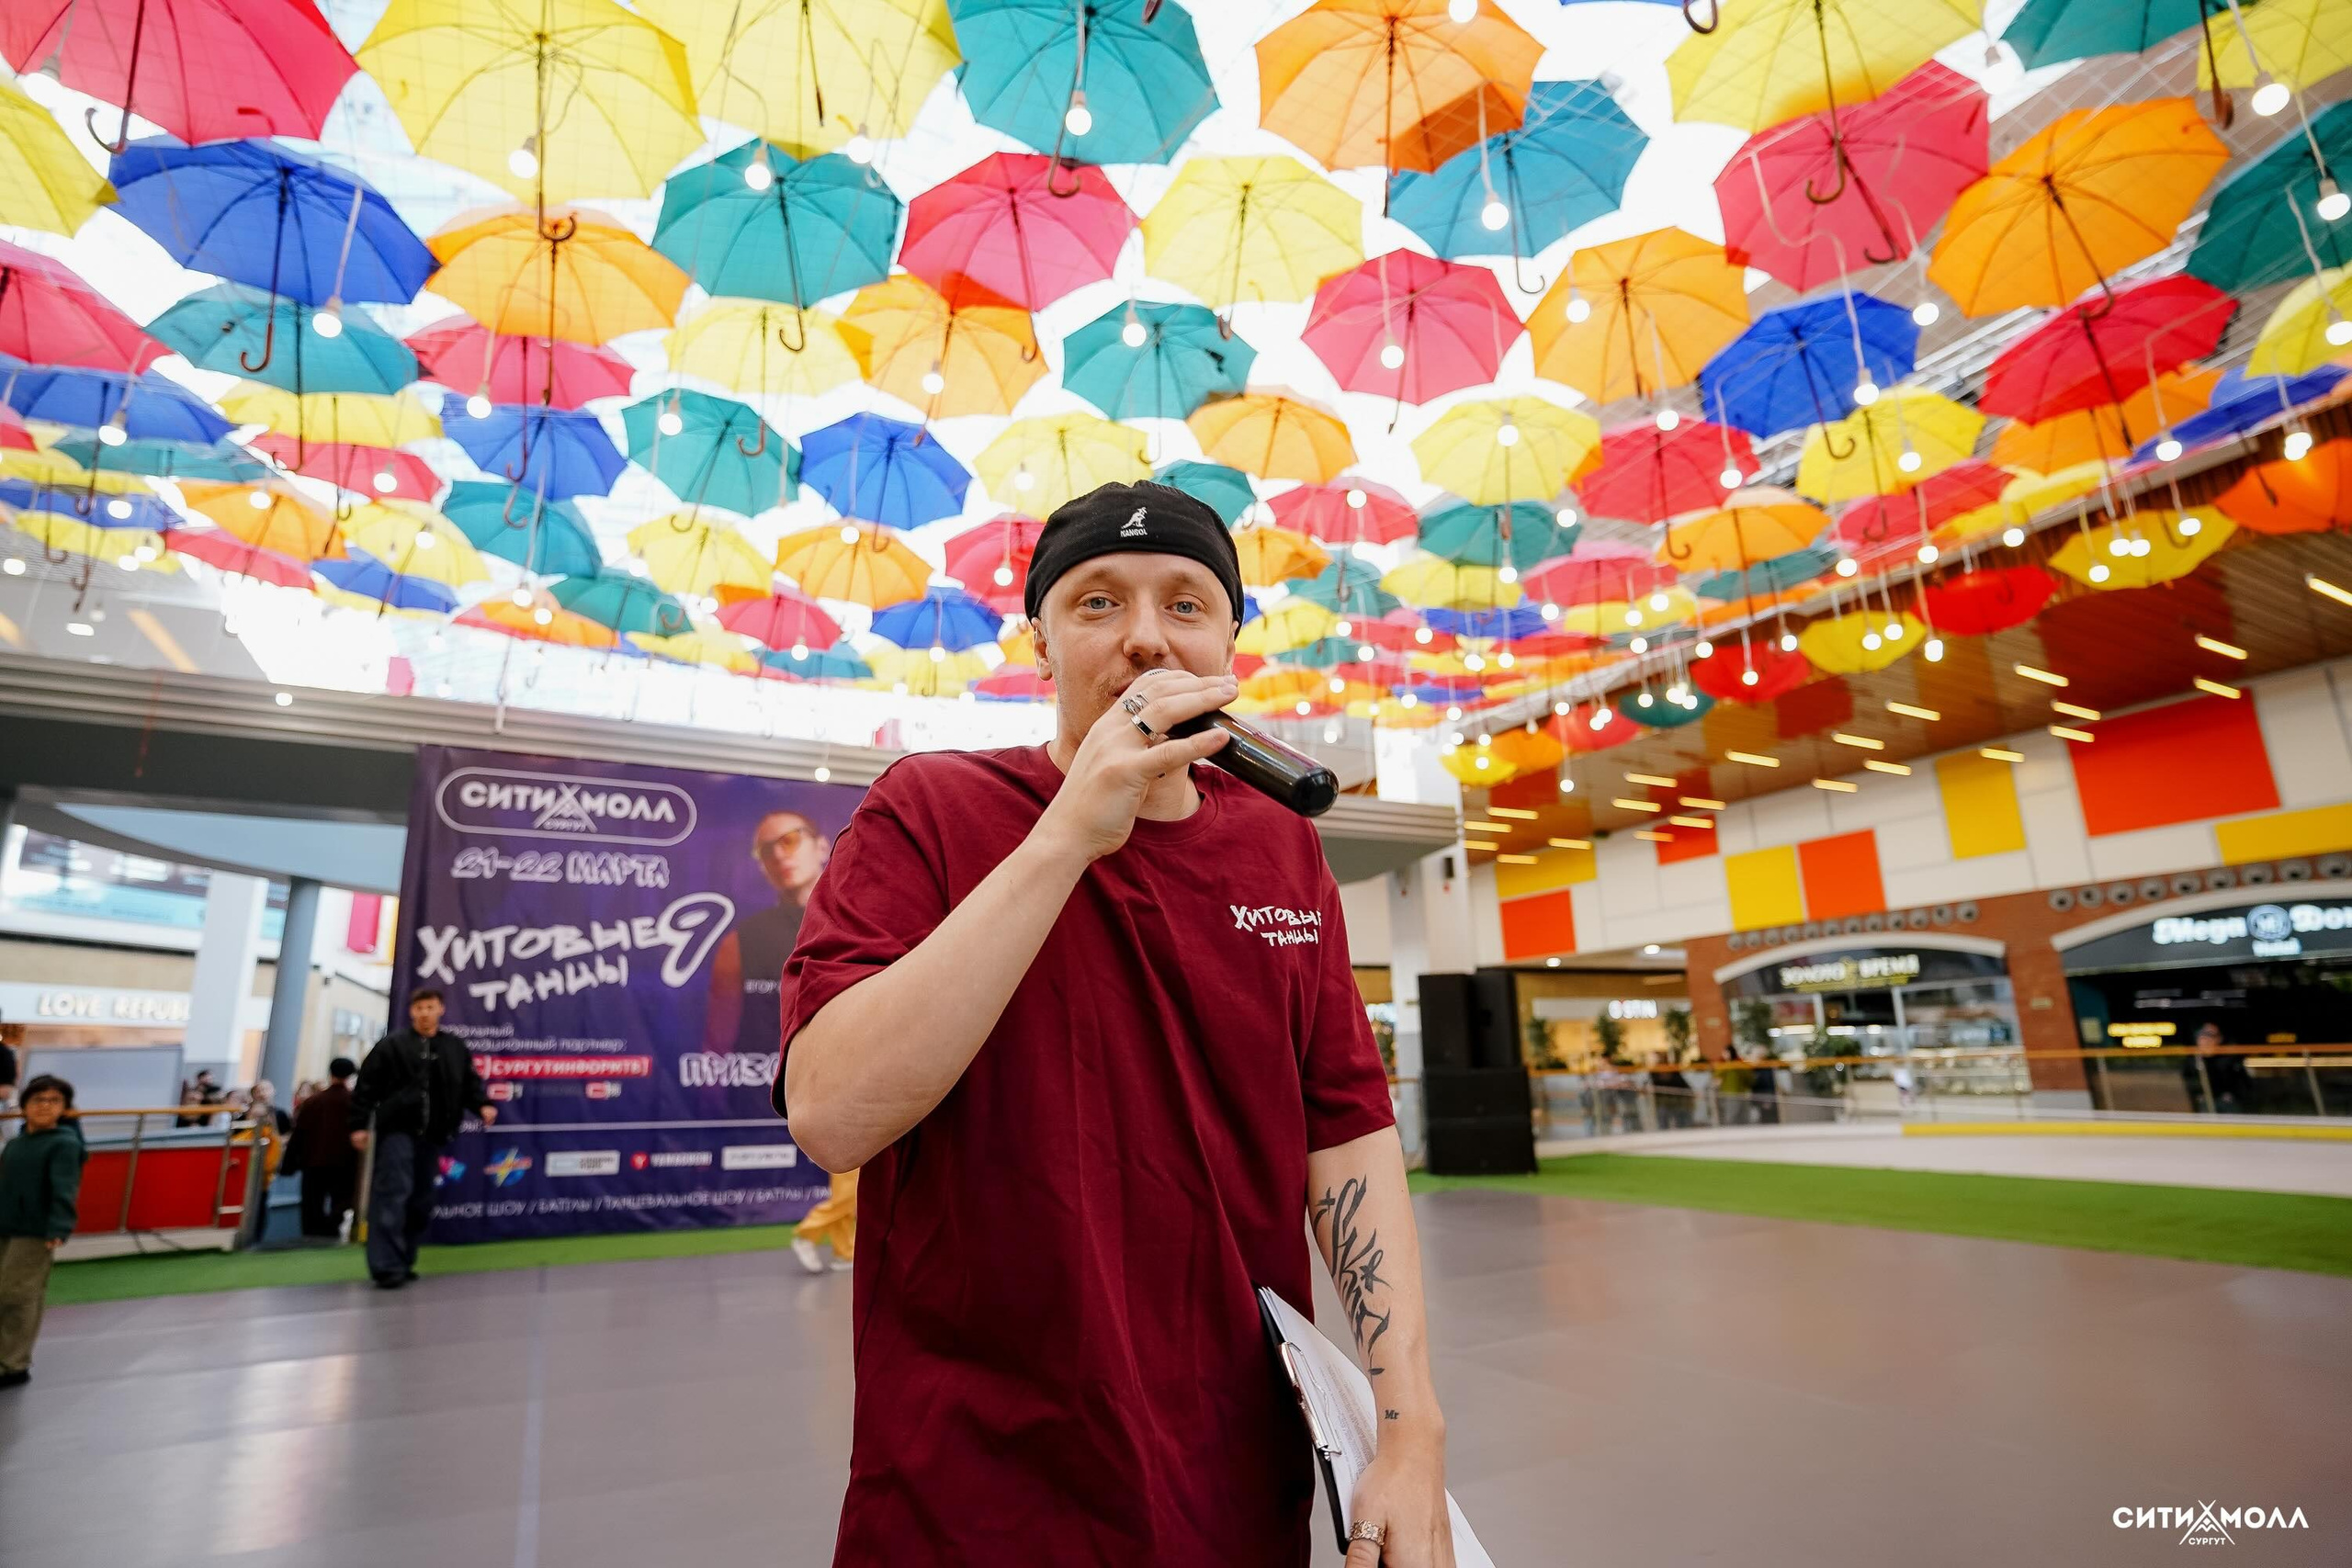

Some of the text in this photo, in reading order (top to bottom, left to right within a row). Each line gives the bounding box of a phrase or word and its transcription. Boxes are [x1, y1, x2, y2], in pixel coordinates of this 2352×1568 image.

[1120, 528, 1148, 538] KANGOL
[450, 845, 671, 890] 21-22 МАРТА
[415, 916, 659, 985] ХИТОВЫЕ
[1261, 927, 1319, 947] ТАНЦЫ
[468, 953, 630, 1012] ТАНЦЫ
[39, 991, 191, 1021] LOVE REPUBL
[488, 1200, 526, 1216] ШОУ
[714, 1189, 746, 1206] ШОУ
[1384, 1409, 1399, 1420] Mr
